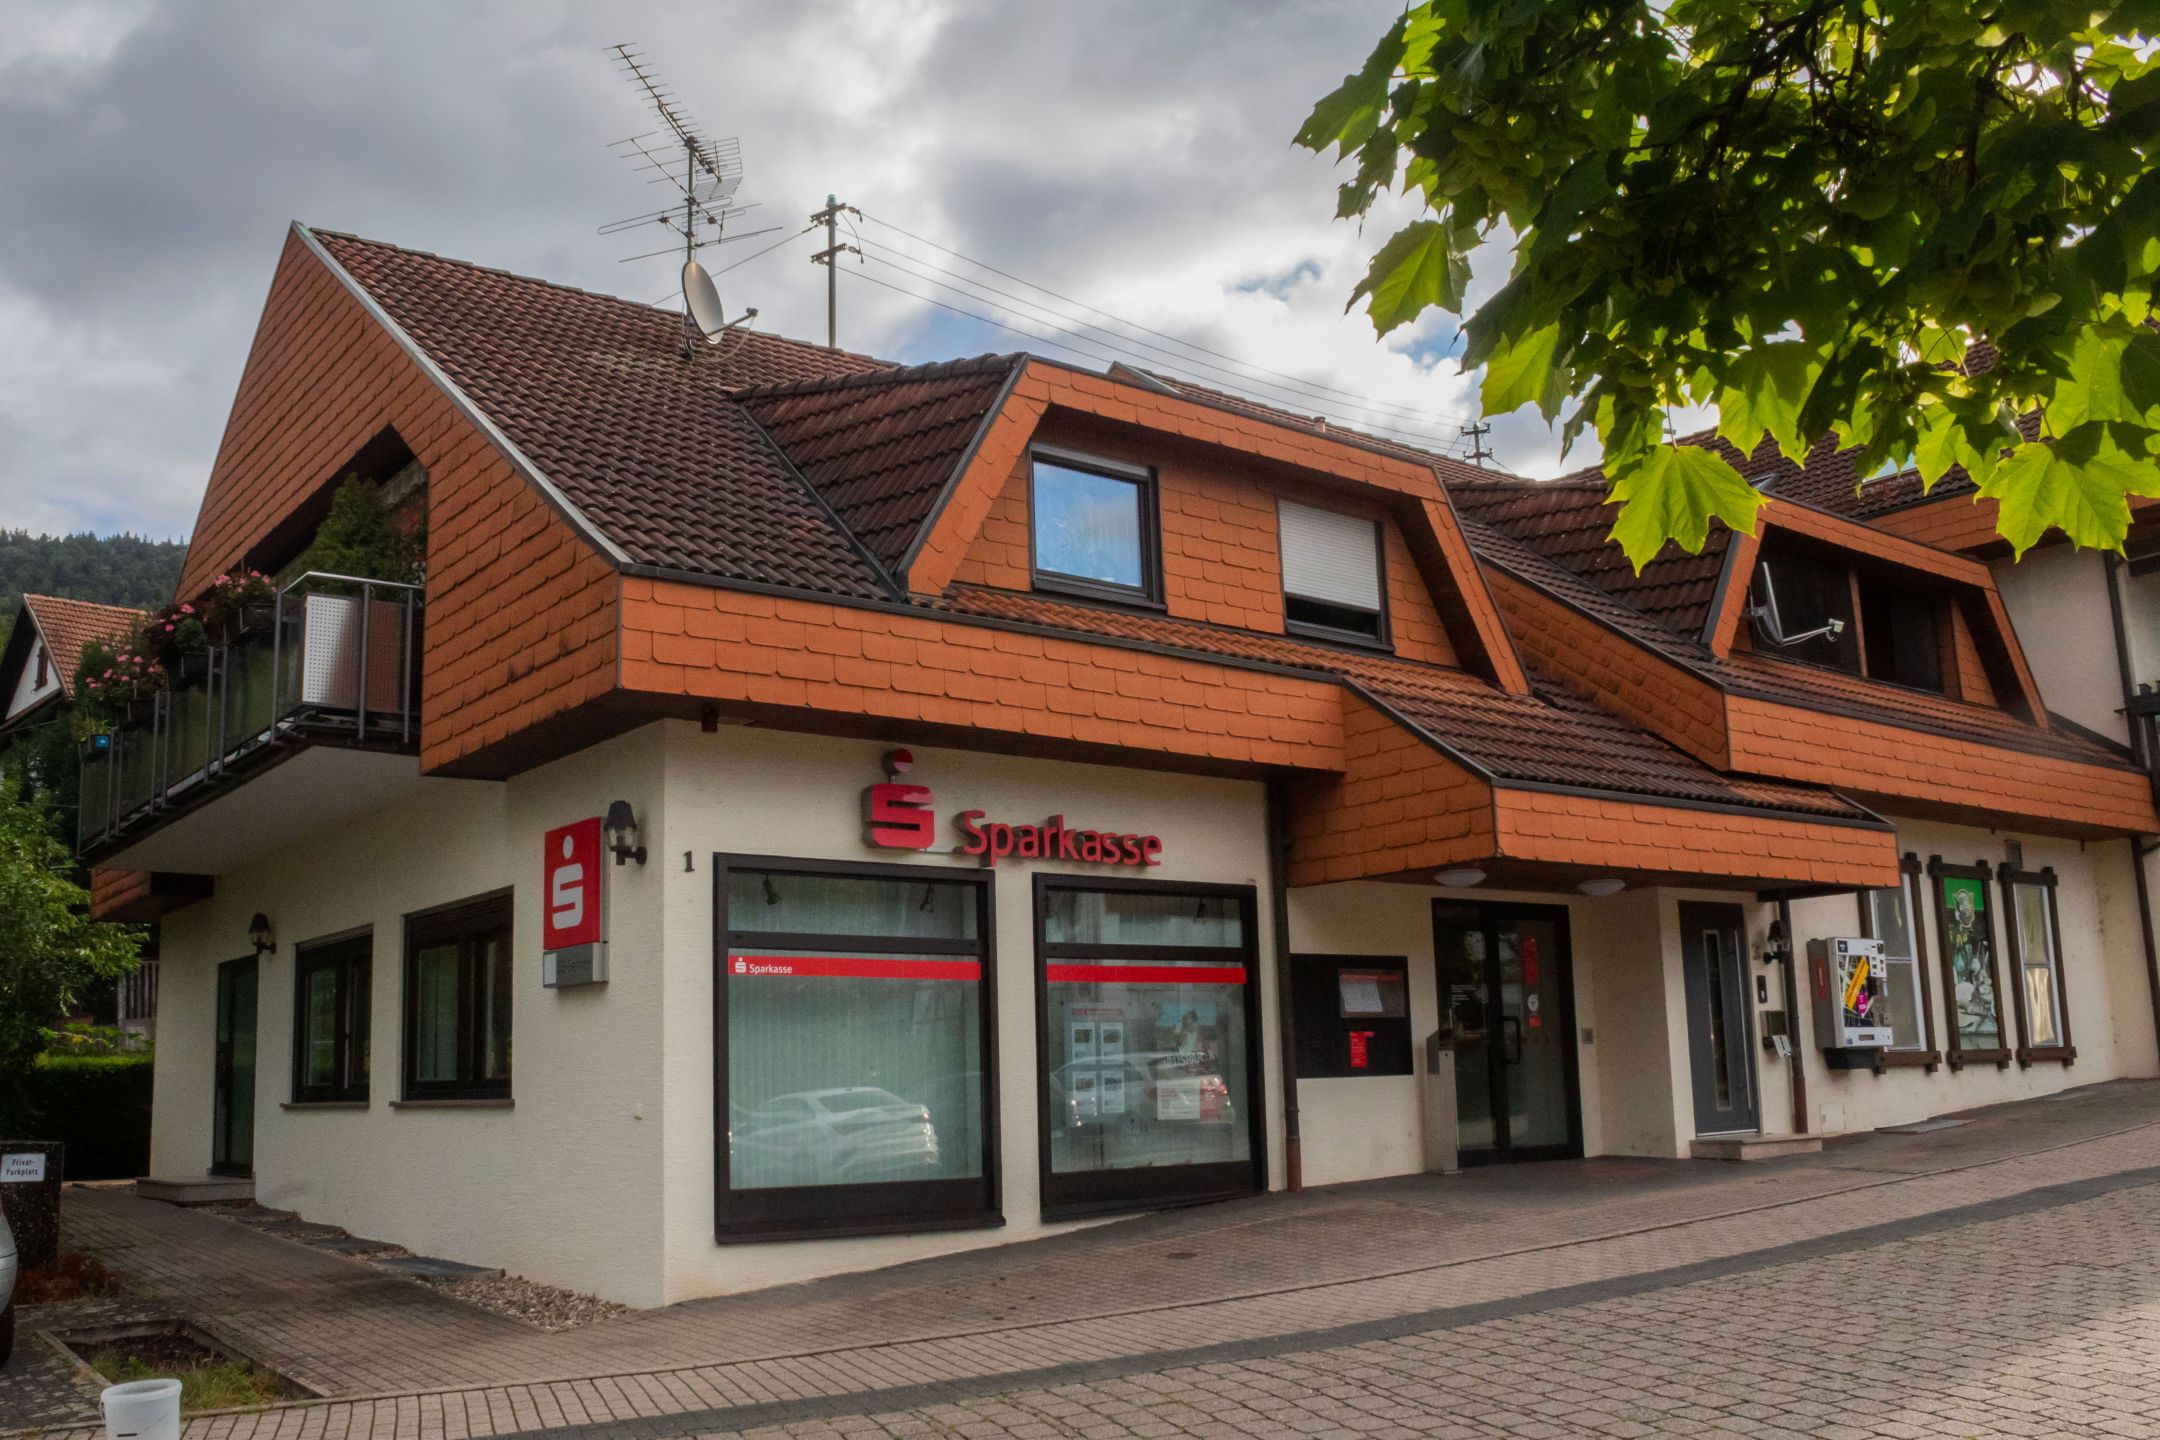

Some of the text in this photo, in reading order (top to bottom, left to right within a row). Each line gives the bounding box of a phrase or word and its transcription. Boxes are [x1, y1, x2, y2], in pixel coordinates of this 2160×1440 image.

[957, 809, 1163, 868] Sparkasse
[682, 850, 696, 874] 1
[749, 964, 793, 975] Sparkasse
[6, 1169, 38, 1177] Parkplatz
